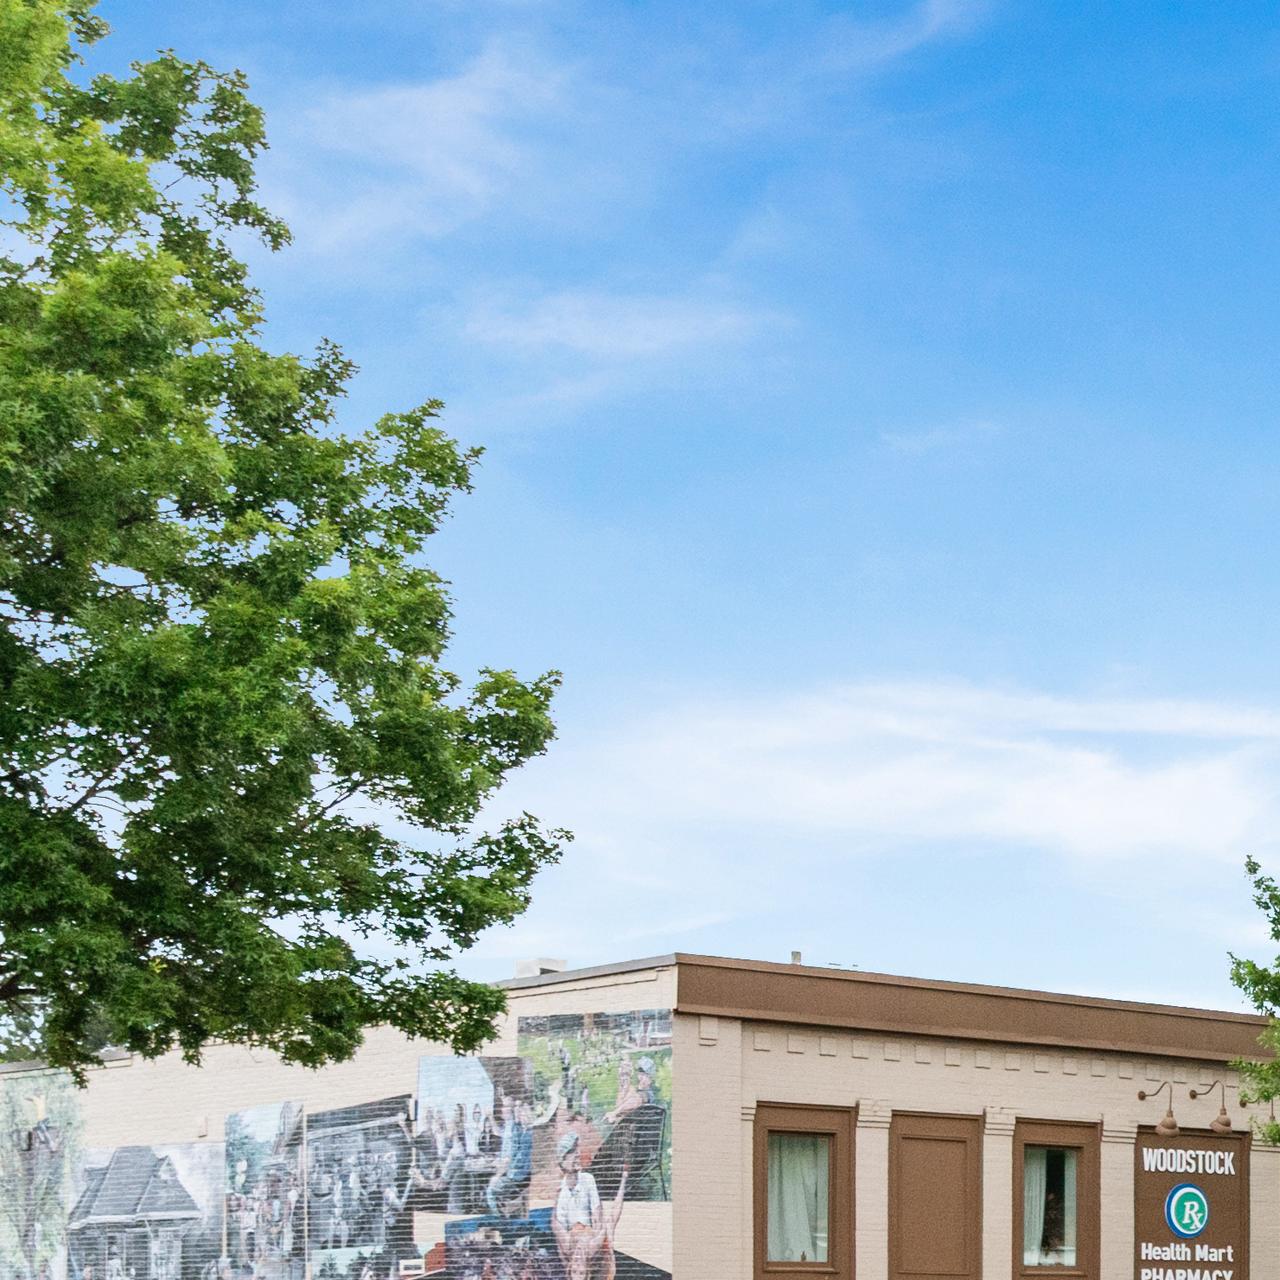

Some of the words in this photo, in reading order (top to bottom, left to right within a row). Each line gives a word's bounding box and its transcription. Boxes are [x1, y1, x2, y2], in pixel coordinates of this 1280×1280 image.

[1142, 1147, 1235, 1175] WOODSTOCK
[1141, 1243, 1191, 1261] Health
[1195, 1244, 1234, 1263] Mart
